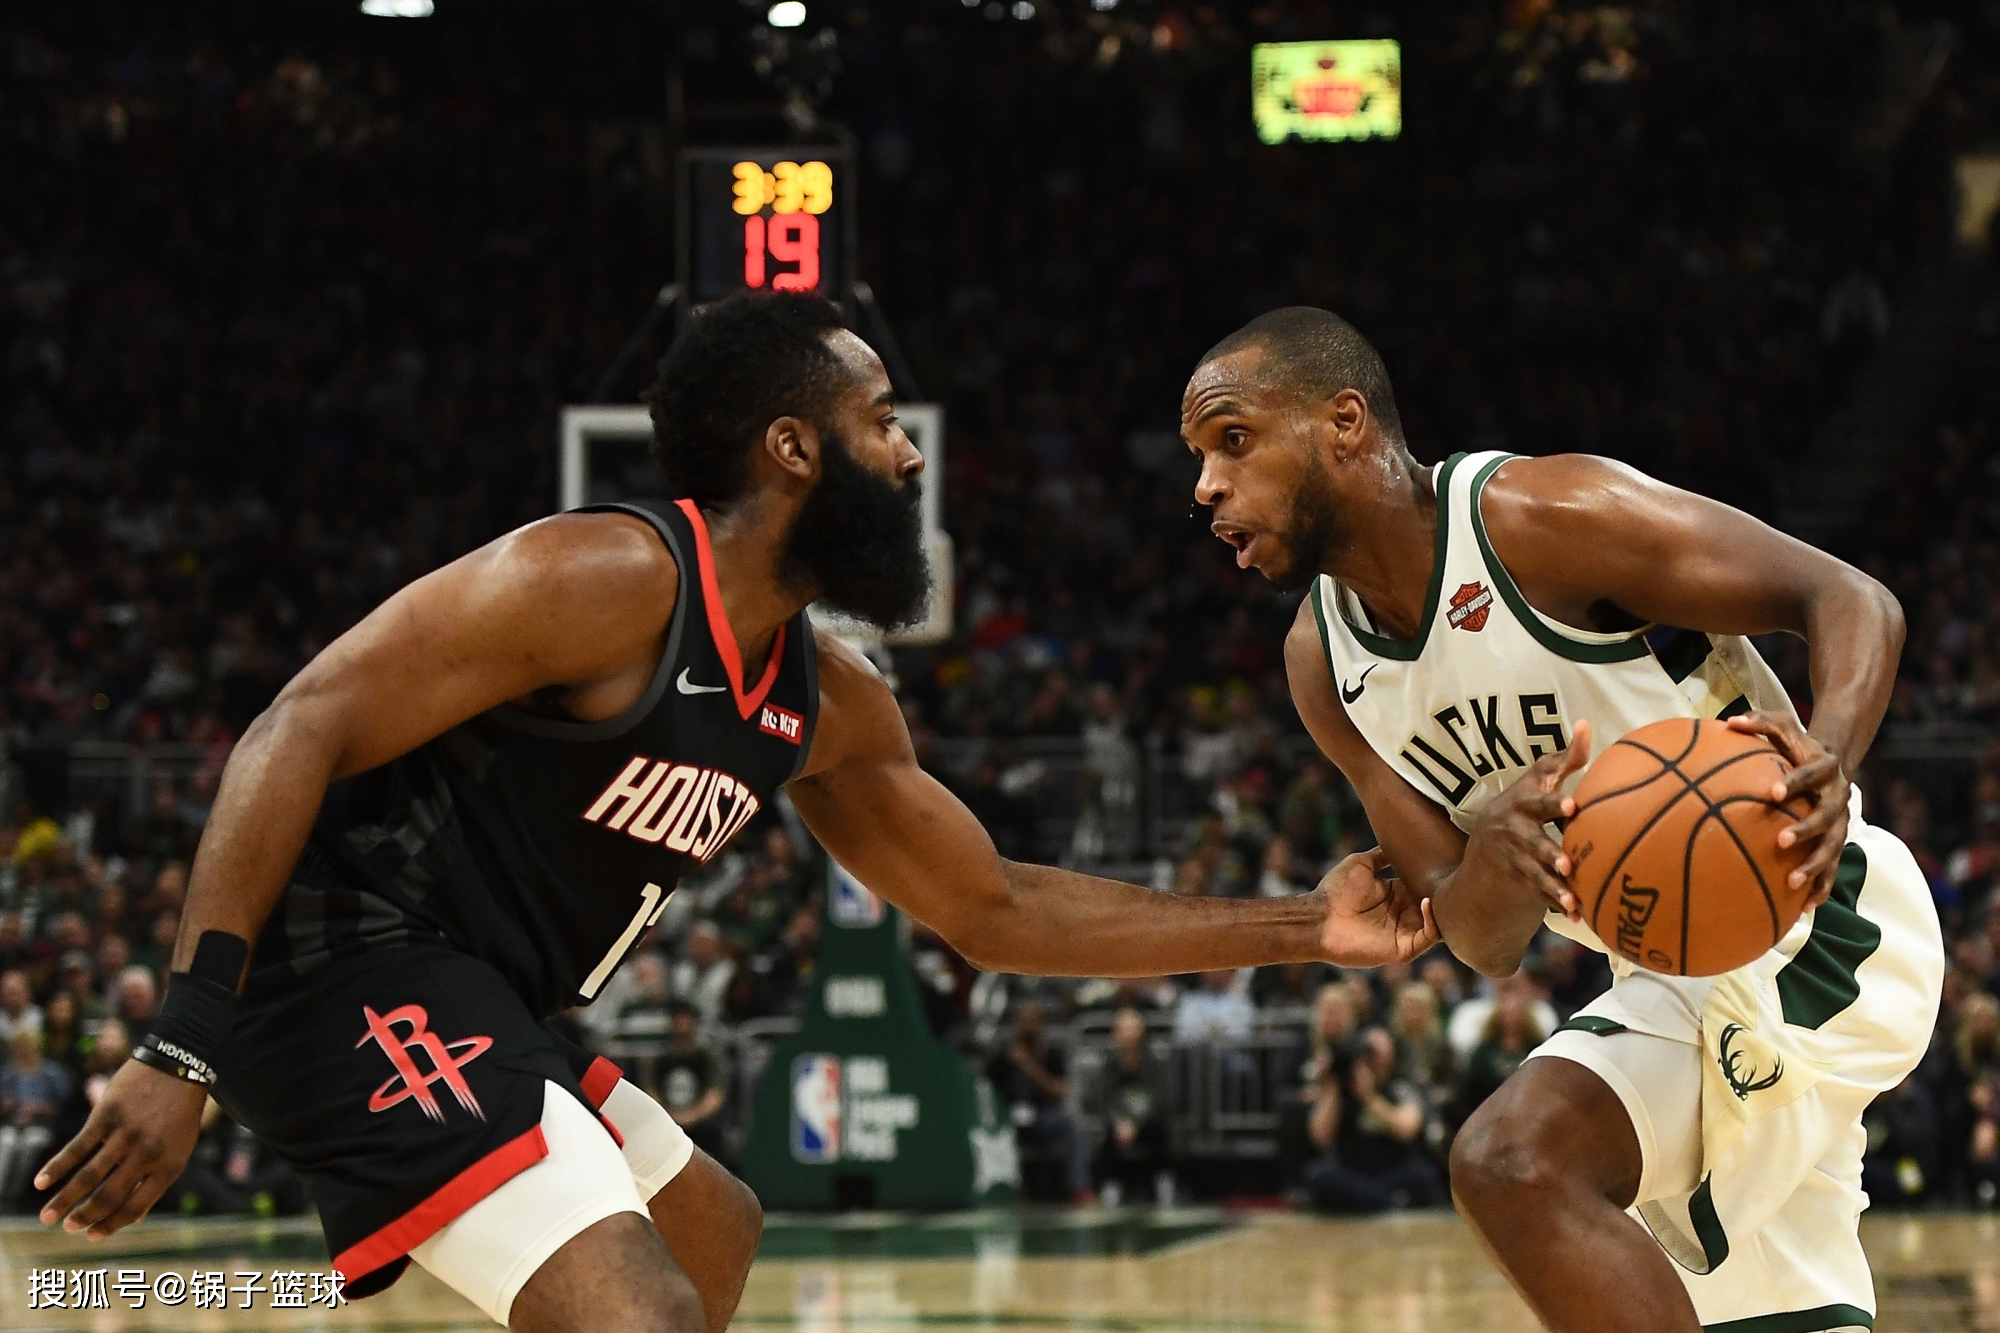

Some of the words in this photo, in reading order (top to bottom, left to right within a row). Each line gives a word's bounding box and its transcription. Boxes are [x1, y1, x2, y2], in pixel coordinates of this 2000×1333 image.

[732, 161, 833, 215] 3:39
[745, 213, 820, 291] 19
[582, 755, 760, 863] HOUSTO
[578, 882, 676, 999] 1
[157, 1040, 207, 1074] ENOUGH
